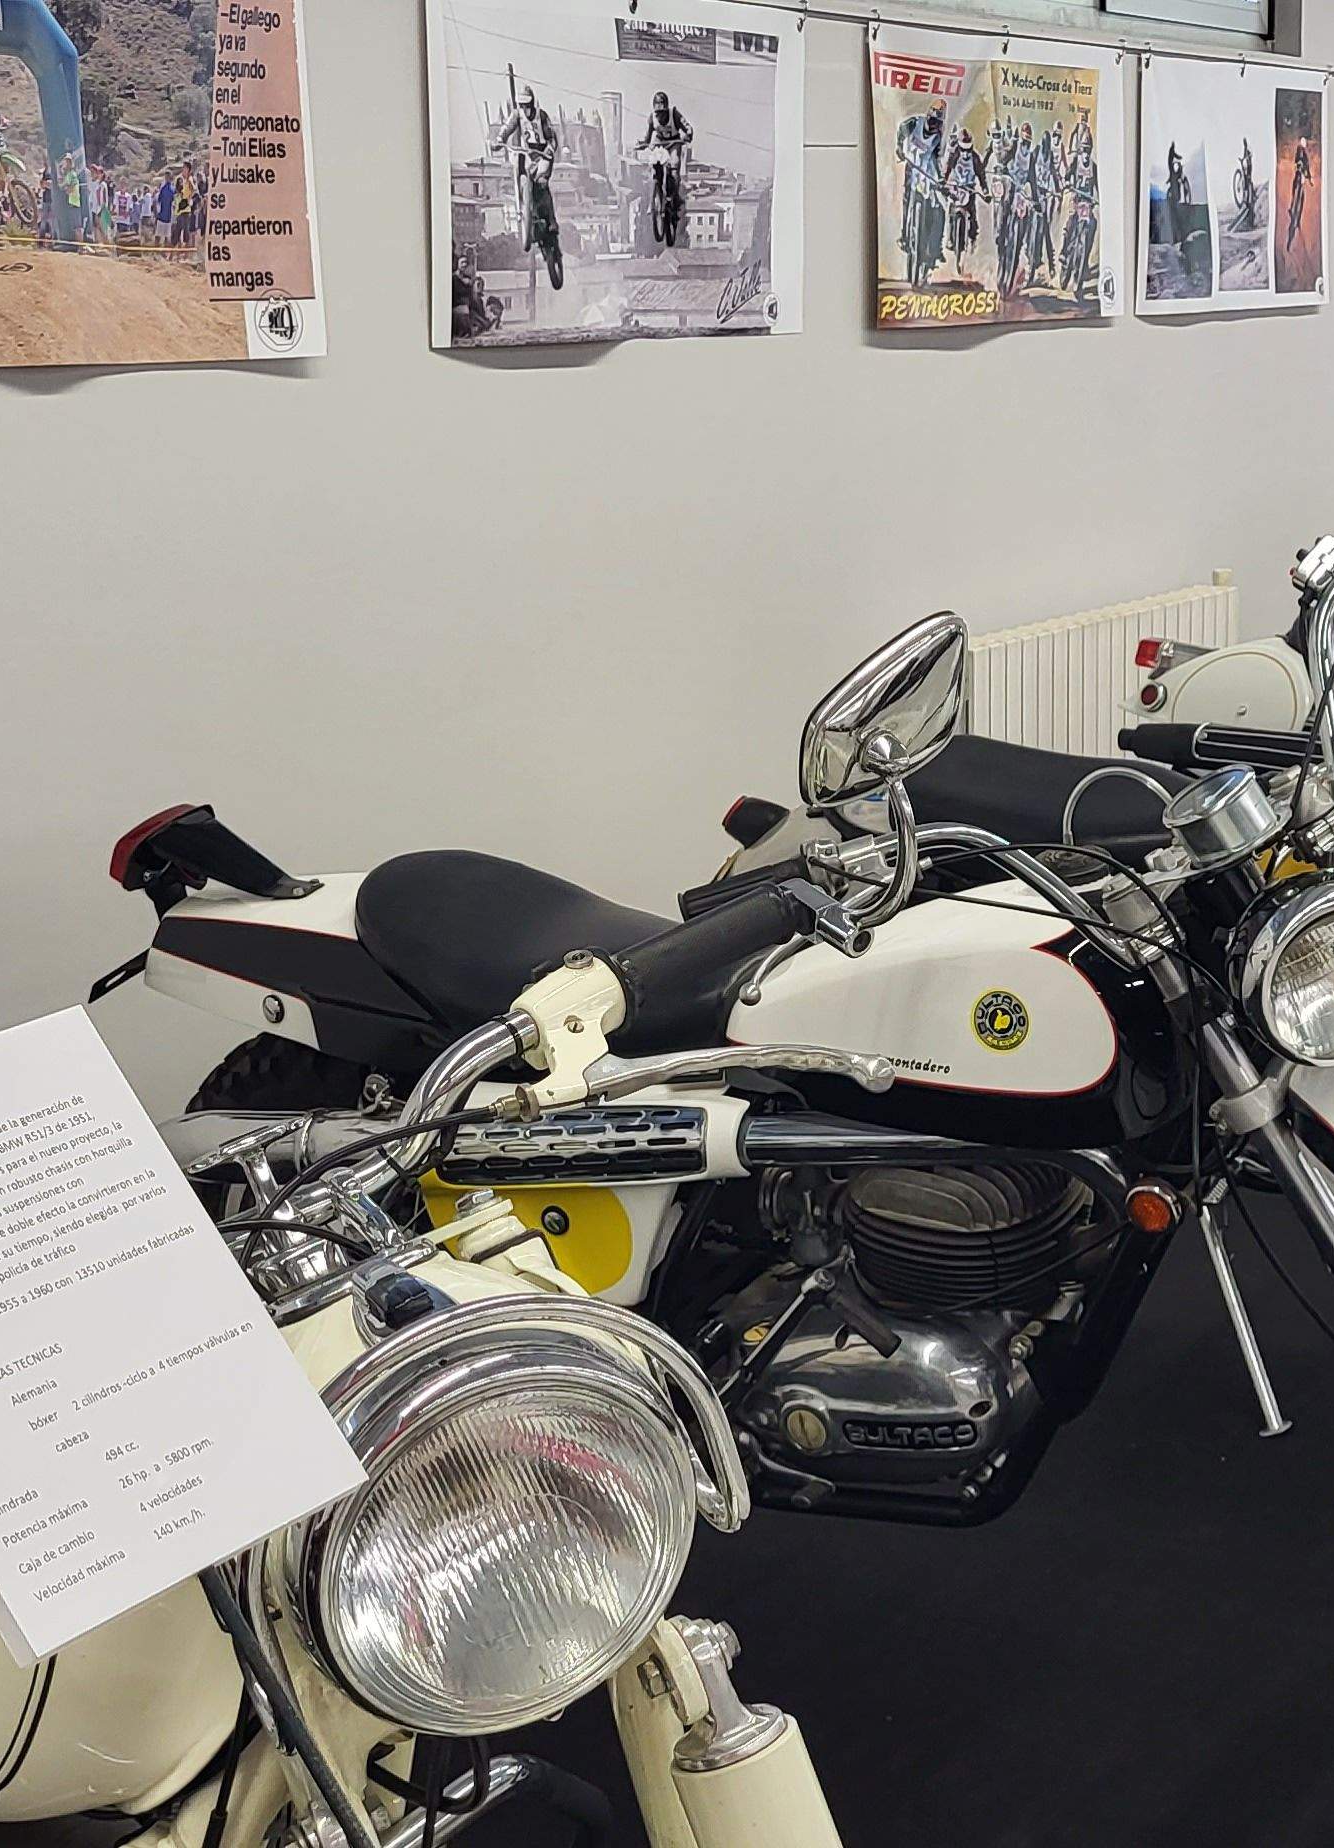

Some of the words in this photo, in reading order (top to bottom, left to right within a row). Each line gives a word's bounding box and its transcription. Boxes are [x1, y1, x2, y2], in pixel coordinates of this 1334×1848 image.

[241, 6, 281, 33] gallego
[218, 34, 233, 55] ya
[234, 35, 246, 52] va
[217, 59, 266, 83] segundo
[874, 51, 966, 97] PIRELLI
[1001, 67, 1010, 86] X
[1011, 72, 1061, 93] Moto-Cross
[1062, 79, 1072, 94] de
[215, 86, 229, 104] en
[230, 84, 241, 105] el
[213, 111, 301, 135] Campeonato
[211, 167, 219, 188] y
[220, 162, 276, 184] Luisake
[210, 192, 226, 209] se
[208, 215, 293, 240] repartieron
[207, 241, 231, 262] las
[210, 270, 274, 292] mangas
[976, 993, 1027, 1035] BULTACO
[6, 1118, 20, 1129] la
[18, 1100, 71, 1127] generación
[70, 1095, 85, 1106] de
[23, 1125, 55, 1144] R51/3
[51, 1120, 69, 1133] de
[67, 1111, 96, 1128] 1951,
[5, 1156, 28, 1174] para
[27, 1150, 39, 1163] el
[38, 1142, 69, 1159] nuevo
[68, 1126, 114, 1150] proyecto,
[110, 1120, 123, 1131] la
[6, 1172, 44, 1192] robusto
[44, 1160, 74, 1178] chasis
[73, 1153, 93, 1167] con
[90, 1137, 133, 1160] horquilla
[6, 1217, 36, 1235] doble
[35, 1205, 67, 1223] efecto
[64, 1200, 78, 1211] la
[77, 1179, 133, 1207] convirtieron
[132, 1173, 146, 1184] en
[143, 1168, 156, 1180] la
[19, 1294, 28, 1304] a
[26, 1282, 54, 1301] 1960
[54, 1276, 74, 1290] con
[74, 1260, 106, 1281] 13510
[105, 1244, 149, 1268] unidades
[146, 1224, 195, 1250] fabricadas
[30, 1255, 44, 1269] de
[43, 1243, 76, 1263] tráfico
[11, 1342, 63, 1371] TECNICAS
[71, 1399, 82, 1412] 2
[148, 1366, 156, 1376] a
[158, 1359, 166, 1371] 4
[165, 1344, 204, 1367] tiempos
[202, 1327, 240, 1350] válvulas
[239, 1321, 253, 1333] en
[10, 1379, 58, 1407] Alemania
[27, 1411, 58, 1431] bóxer
[845, 1423, 975, 1445] BULTACO
[55, 1431, 90, 1453] cabeza
[105, 1445, 124, 1462] 494
[124, 1441, 140, 1453] cc.
[118, 1474, 134, 1489] 26
[152, 1463, 161, 1473] a
[164, 1446, 191, 1466] 5800
[139, 1501, 148, 1512] 4
[146, 1475, 203, 1508] velocidades
[1, 1519, 48, 1548] Potencia
[47, 1499, 89, 1525] máxima
[153, 1522, 174, 1540] 140
[171, 1508, 206, 1530] km./h.
[18, 1557, 42, 1574] Caja
[42, 1550, 58, 1563] de
[57, 1530, 95, 1555] cambio
[32, 1568, 85, 1602] Velocidad
[85, 1550, 126, 1576] máxima
